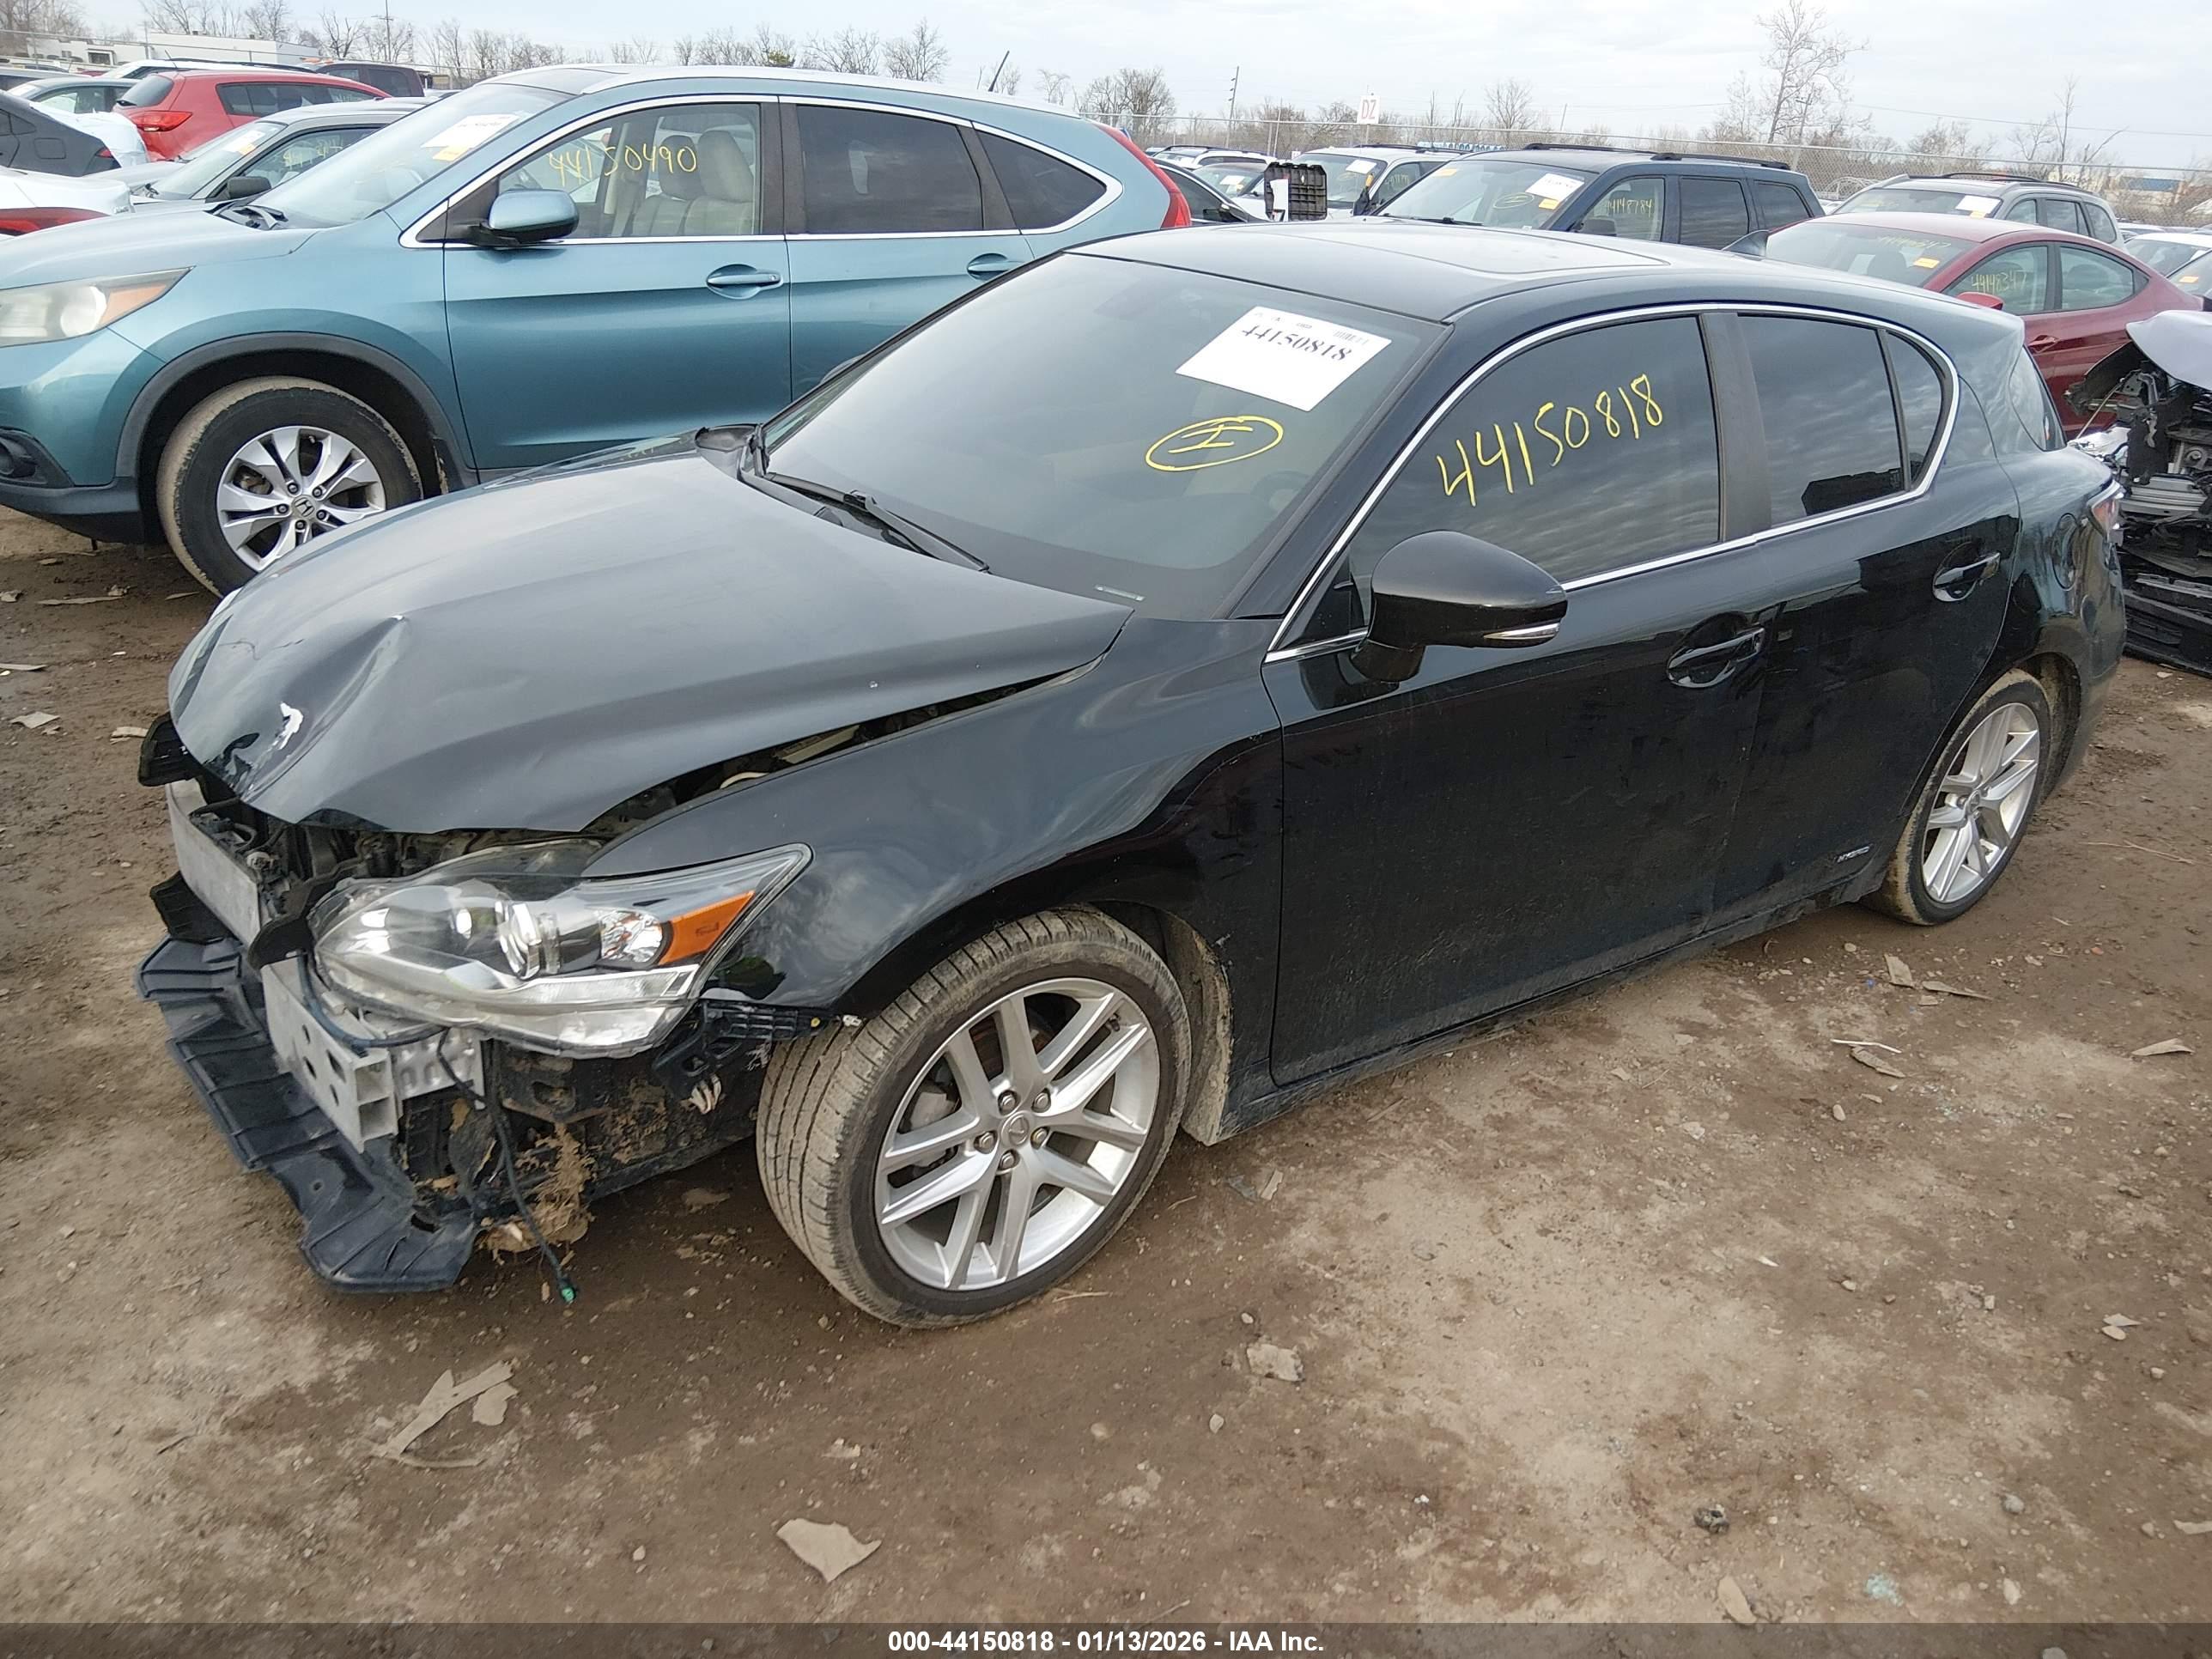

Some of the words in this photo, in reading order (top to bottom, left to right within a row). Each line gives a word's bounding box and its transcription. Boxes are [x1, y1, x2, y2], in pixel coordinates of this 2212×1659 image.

[549, 143, 697, 187] 44150490
[1242, 325, 1352, 361] 44150818
[1437, 374, 1663, 507] 44150818
